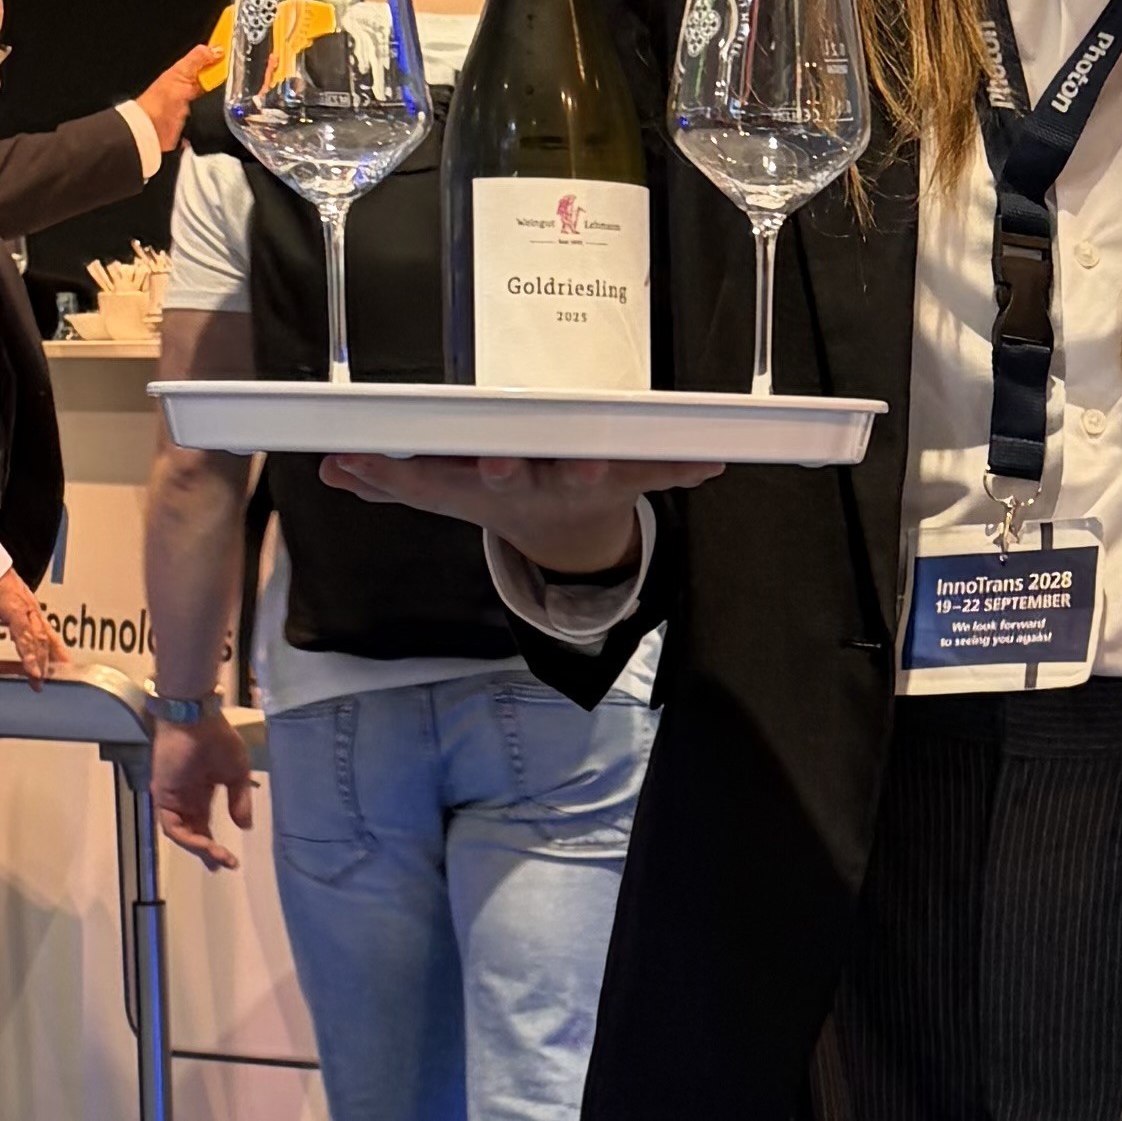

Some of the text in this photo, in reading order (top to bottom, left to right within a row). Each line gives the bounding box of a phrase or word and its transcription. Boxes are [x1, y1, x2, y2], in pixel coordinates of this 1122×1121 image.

[1051, 31, 1115, 114] Photon
[507, 276, 627, 304] Goldriesling
[556, 310, 588, 323] 2025
[936, 570, 1073, 596] InnoTrans 2028
[983, 593, 1072, 613] SEPTEMBER
[952, 618, 1047, 633] We look forward
[940, 632, 1053, 647] to seeing you again!
